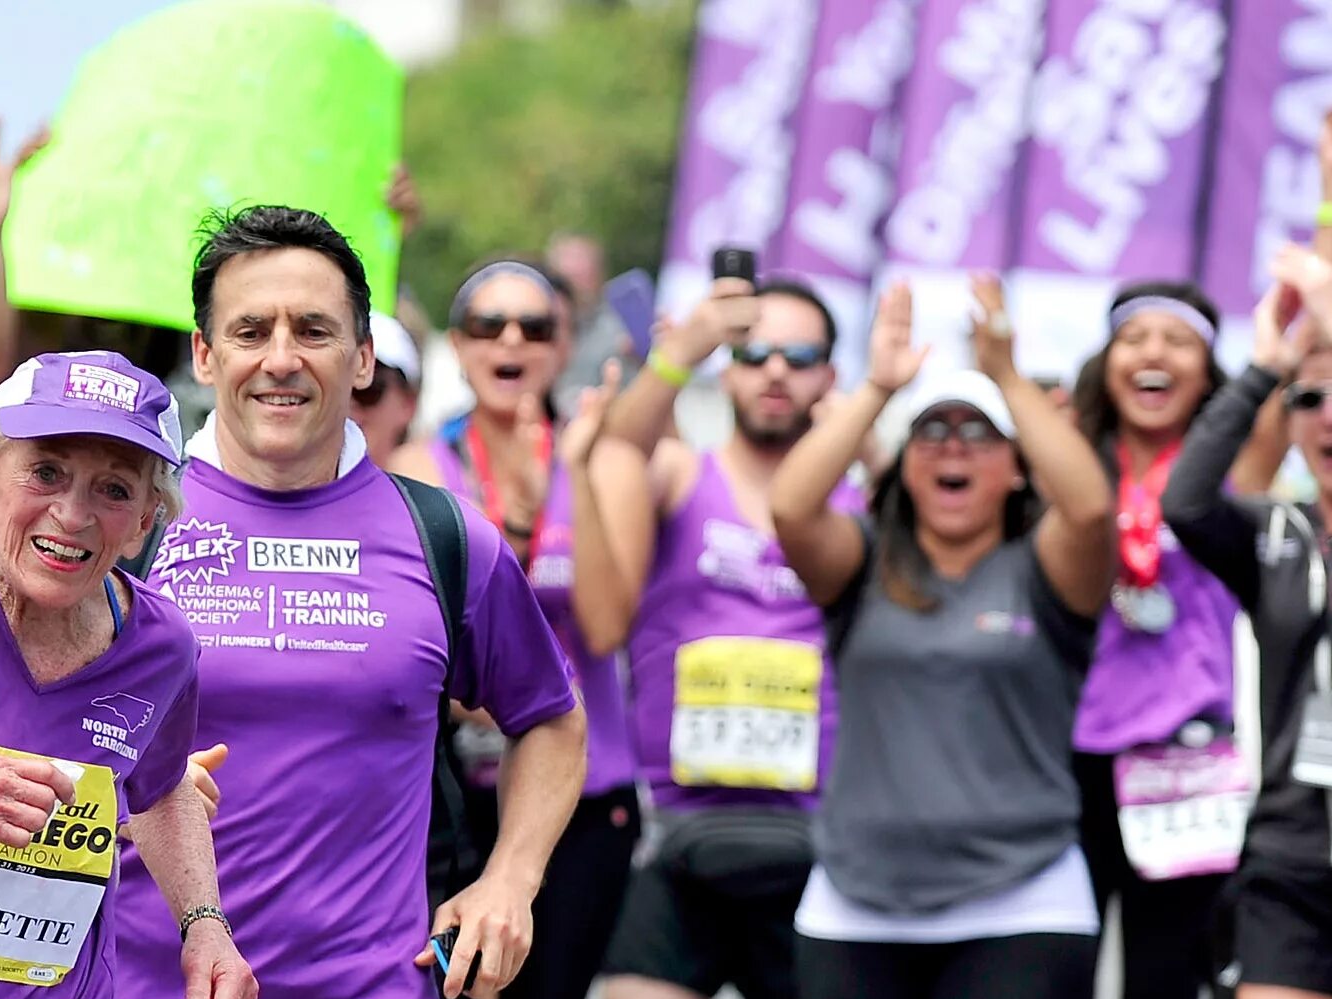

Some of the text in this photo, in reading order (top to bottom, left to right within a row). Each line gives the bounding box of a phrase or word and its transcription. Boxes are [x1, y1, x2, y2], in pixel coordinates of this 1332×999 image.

[69, 375, 137, 406] TEAM
[168, 537, 227, 564] FLEX
[254, 541, 359, 568] BRENNY
[178, 583, 265, 600] LEUKEMIA &
[282, 590, 369, 609] TEAM IN
[177, 598, 262, 612] LYMPHOMA
[184, 611, 240, 625] OCIETY
[282, 608, 386, 628] TRAINING
[220, 635, 272, 648] RUNNERS
[287, 638, 369, 652] UnitedHealthcare
[81, 717, 128, 742] NORTH
[92, 734, 139, 761] CAROLINA
[1, 862, 13, 871] 31,
[15, 865, 37, 874] 2015
